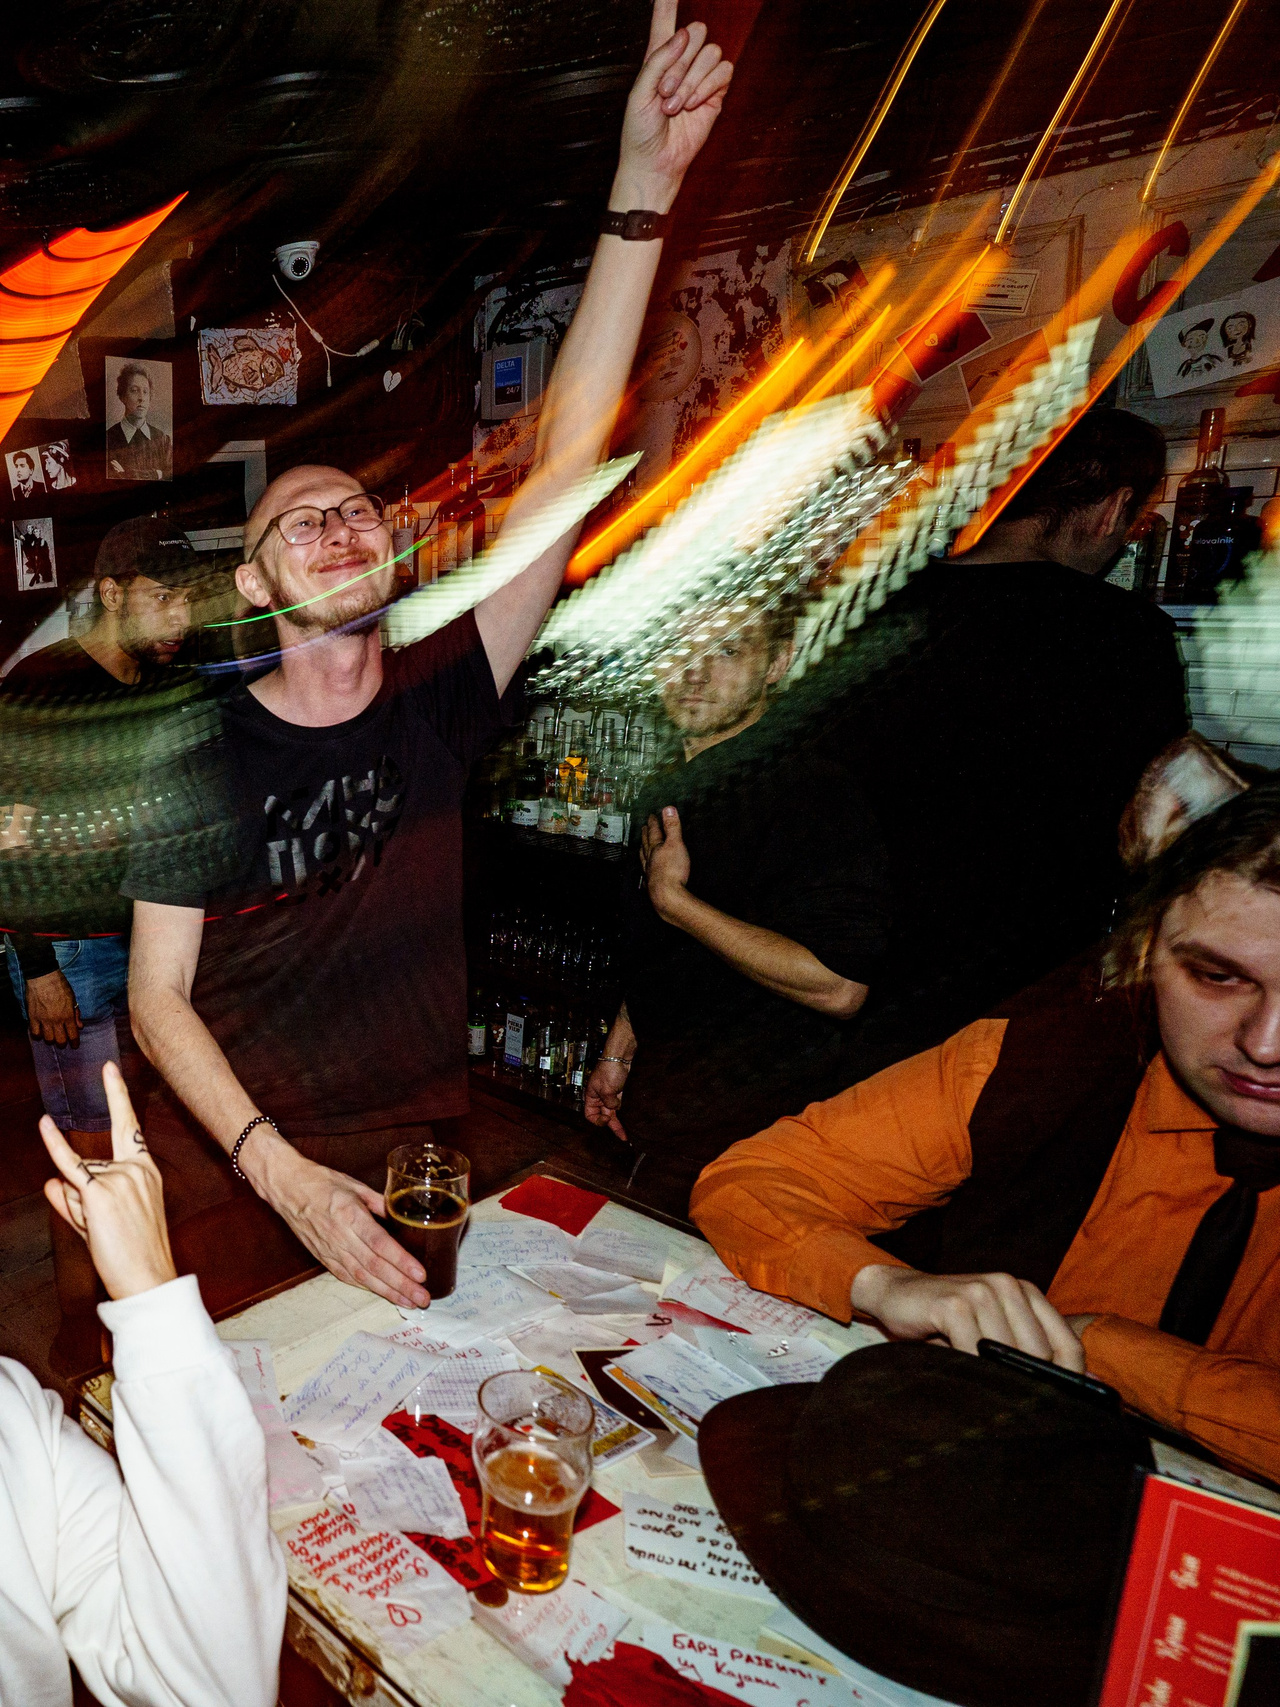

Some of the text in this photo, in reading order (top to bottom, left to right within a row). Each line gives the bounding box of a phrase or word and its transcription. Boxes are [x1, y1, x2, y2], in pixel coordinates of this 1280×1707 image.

[496, 360, 516, 370] DELTA
[673, 1633, 828, 1687] БАРУ РАЗБИТЫХ
[714, 1660, 781, 1690] Казани
